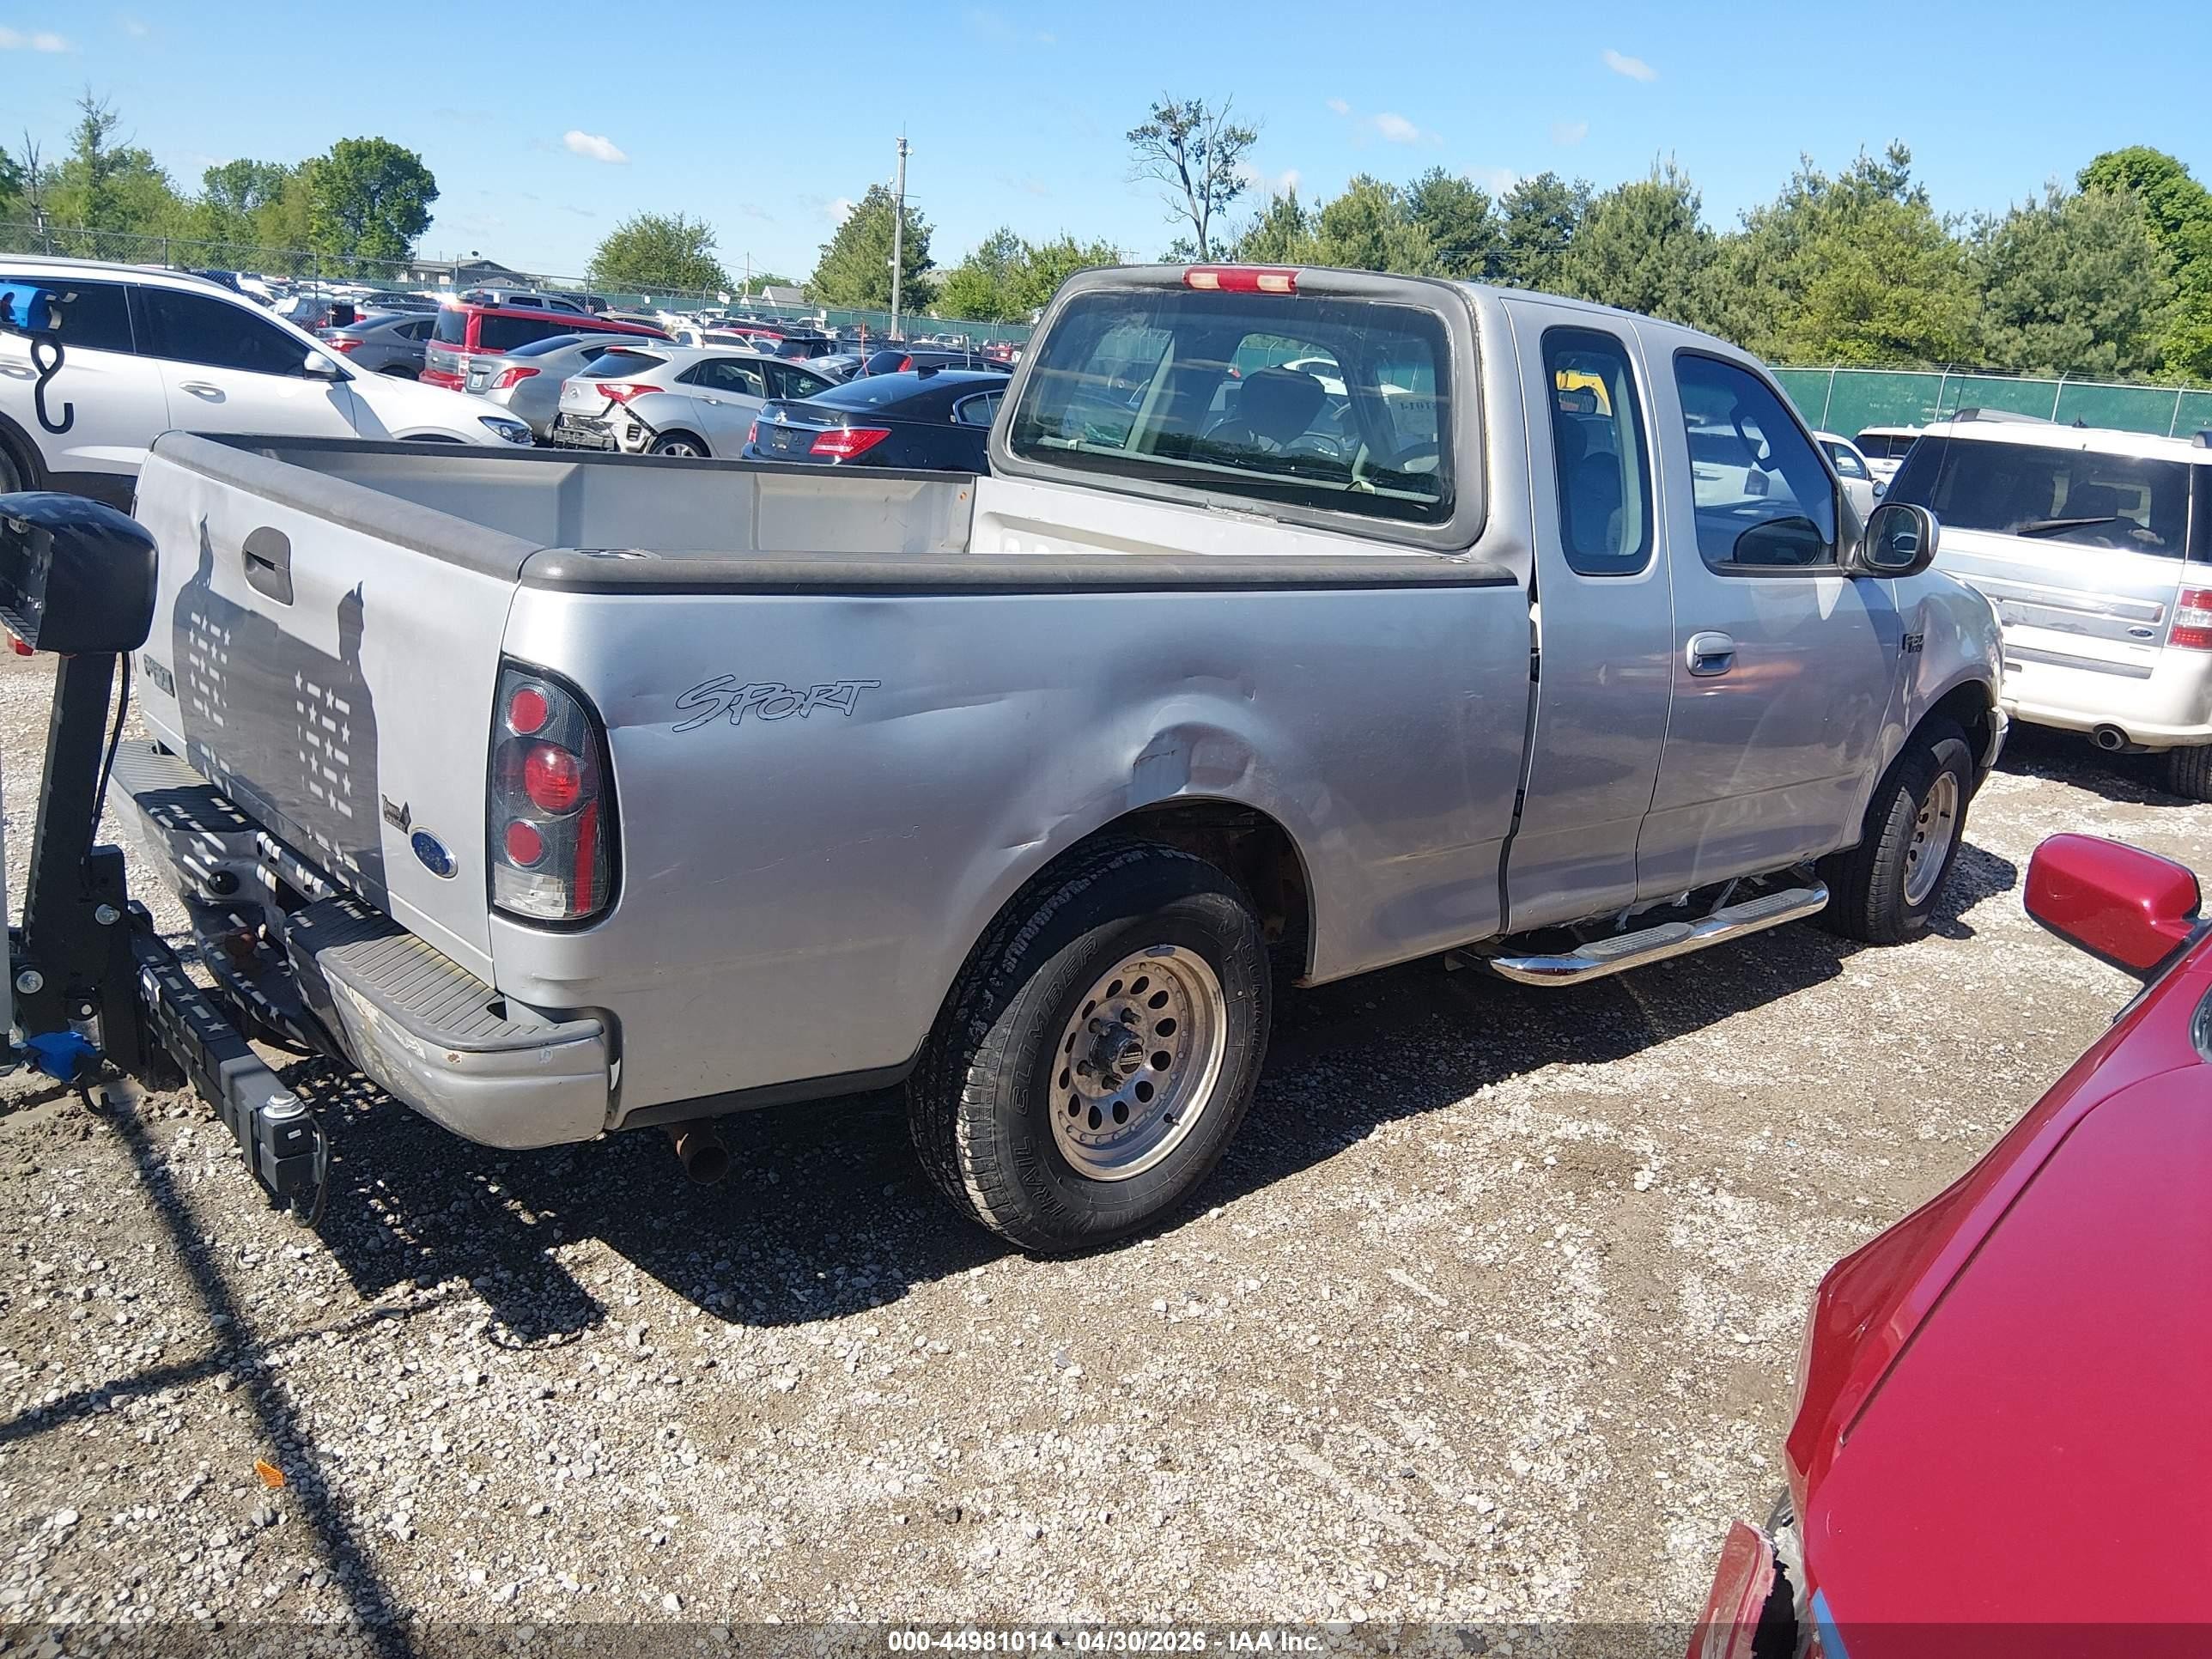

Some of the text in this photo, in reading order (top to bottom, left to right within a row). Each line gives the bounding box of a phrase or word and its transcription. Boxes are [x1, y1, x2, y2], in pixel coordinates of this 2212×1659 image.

[672, 673, 881, 732] SPORT
[1012, 935, 1098, 1216] TRAIL CLIMBER
